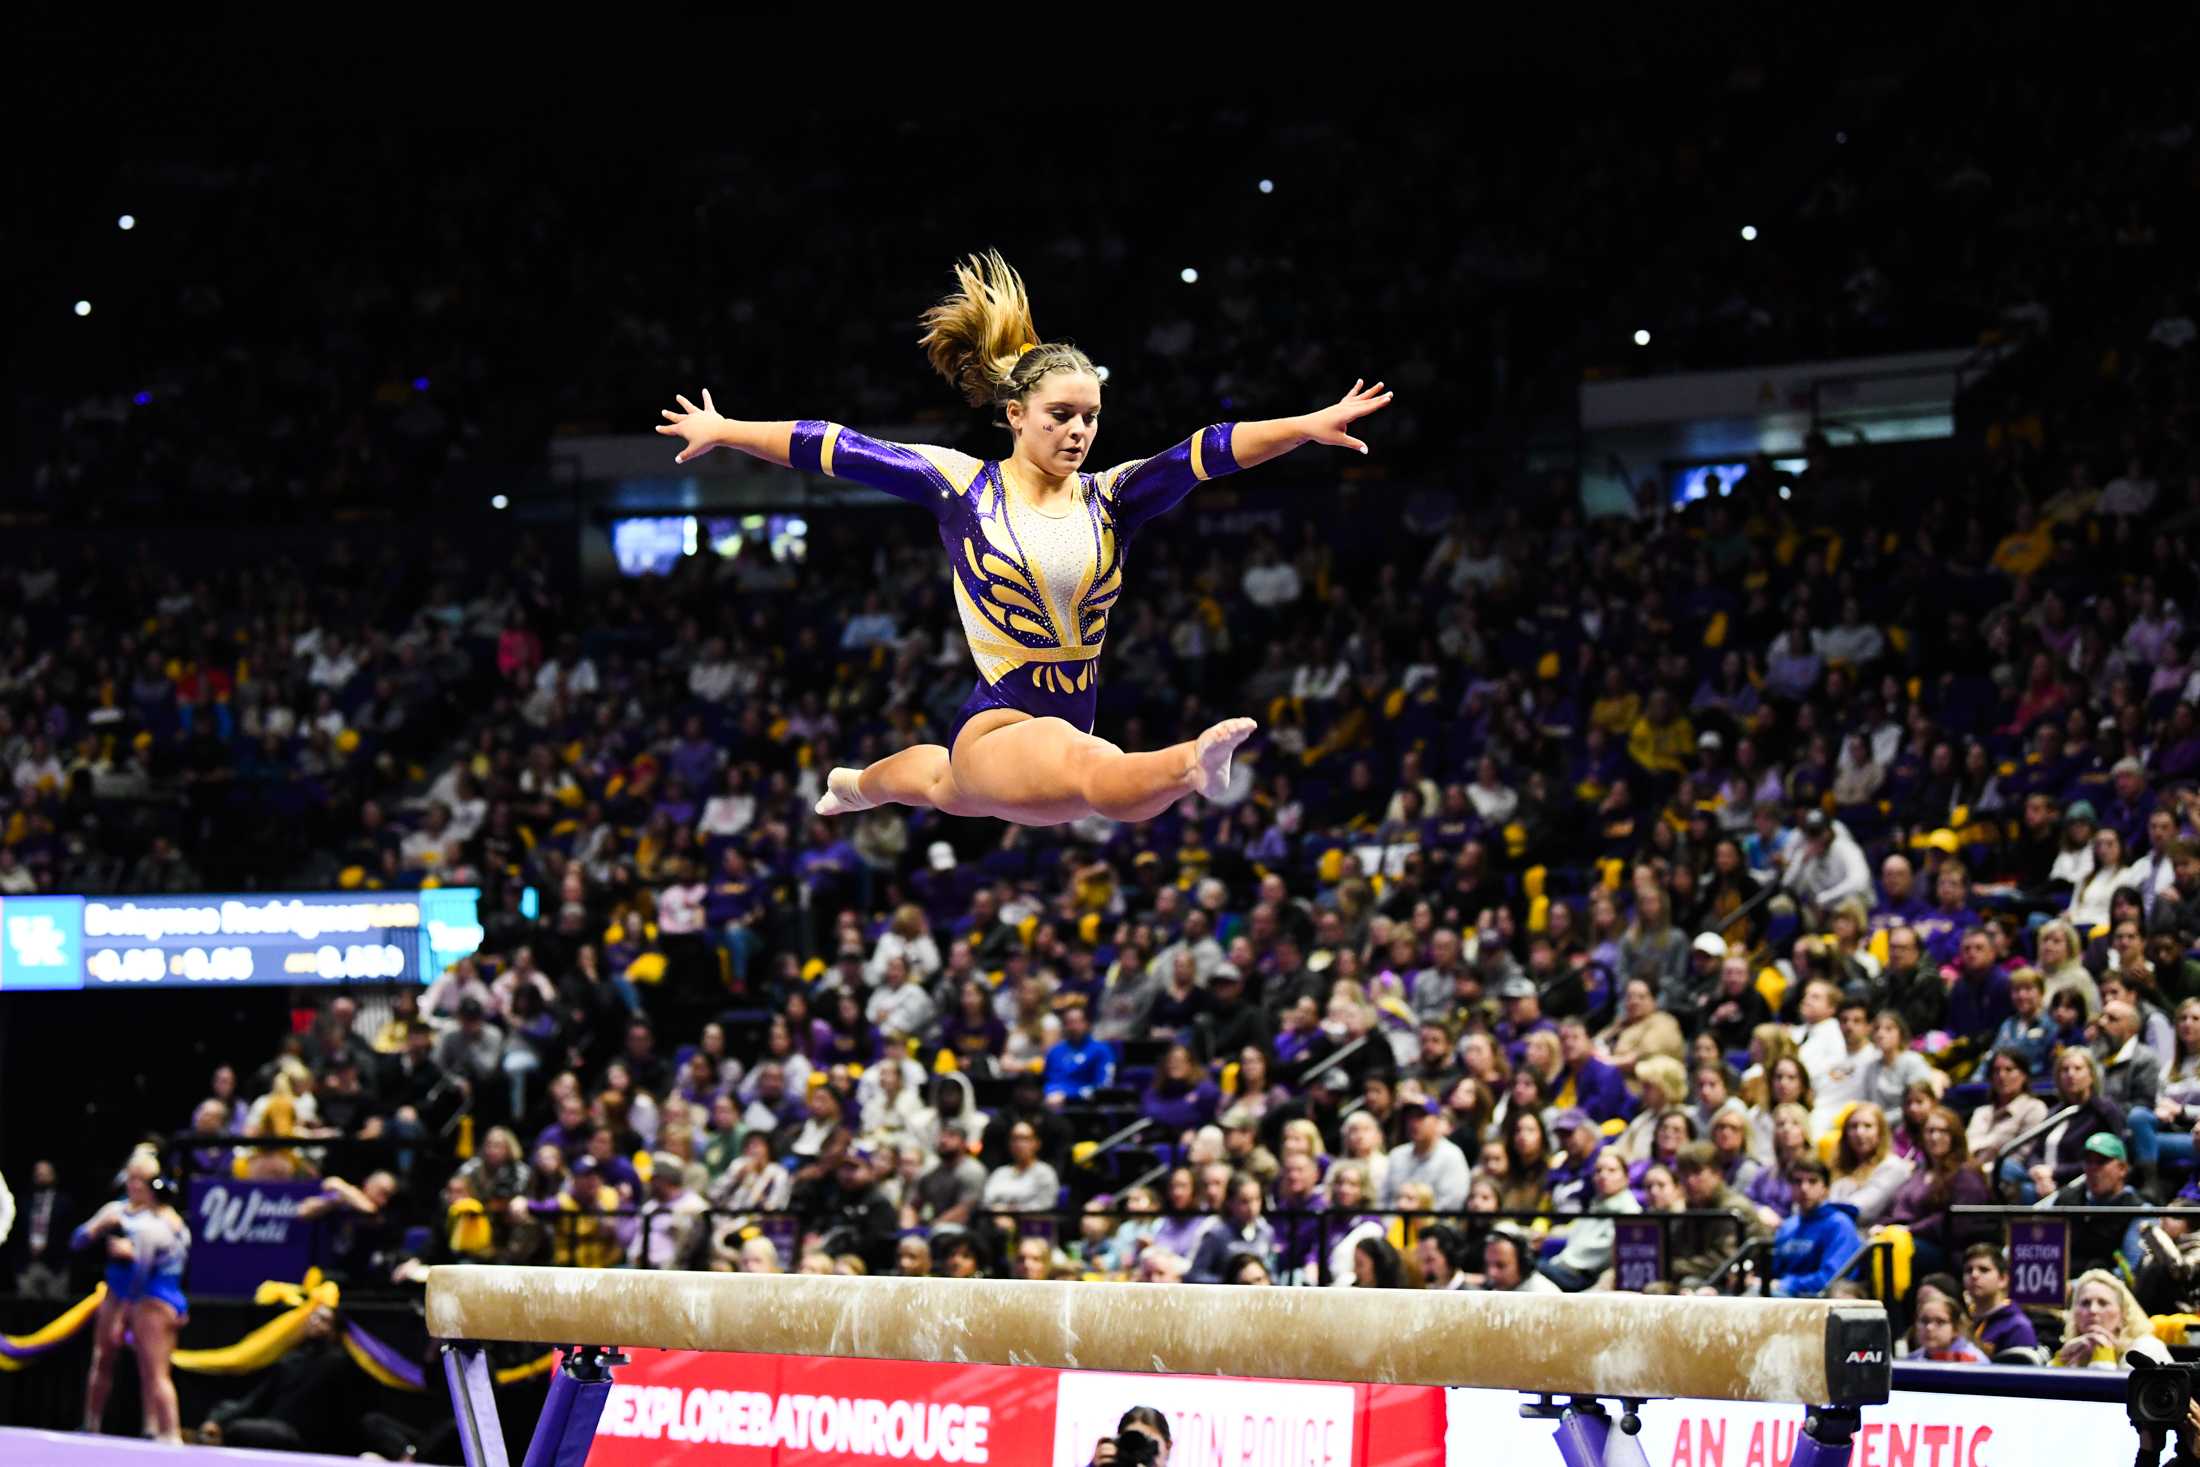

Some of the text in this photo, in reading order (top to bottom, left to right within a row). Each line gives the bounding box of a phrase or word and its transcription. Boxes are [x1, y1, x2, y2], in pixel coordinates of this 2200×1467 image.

[2015, 1245, 2060, 1259] SECTION
[2015, 1263, 2058, 1294] 104
[1671, 1417, 1994, 1467] AN AUENTIC
